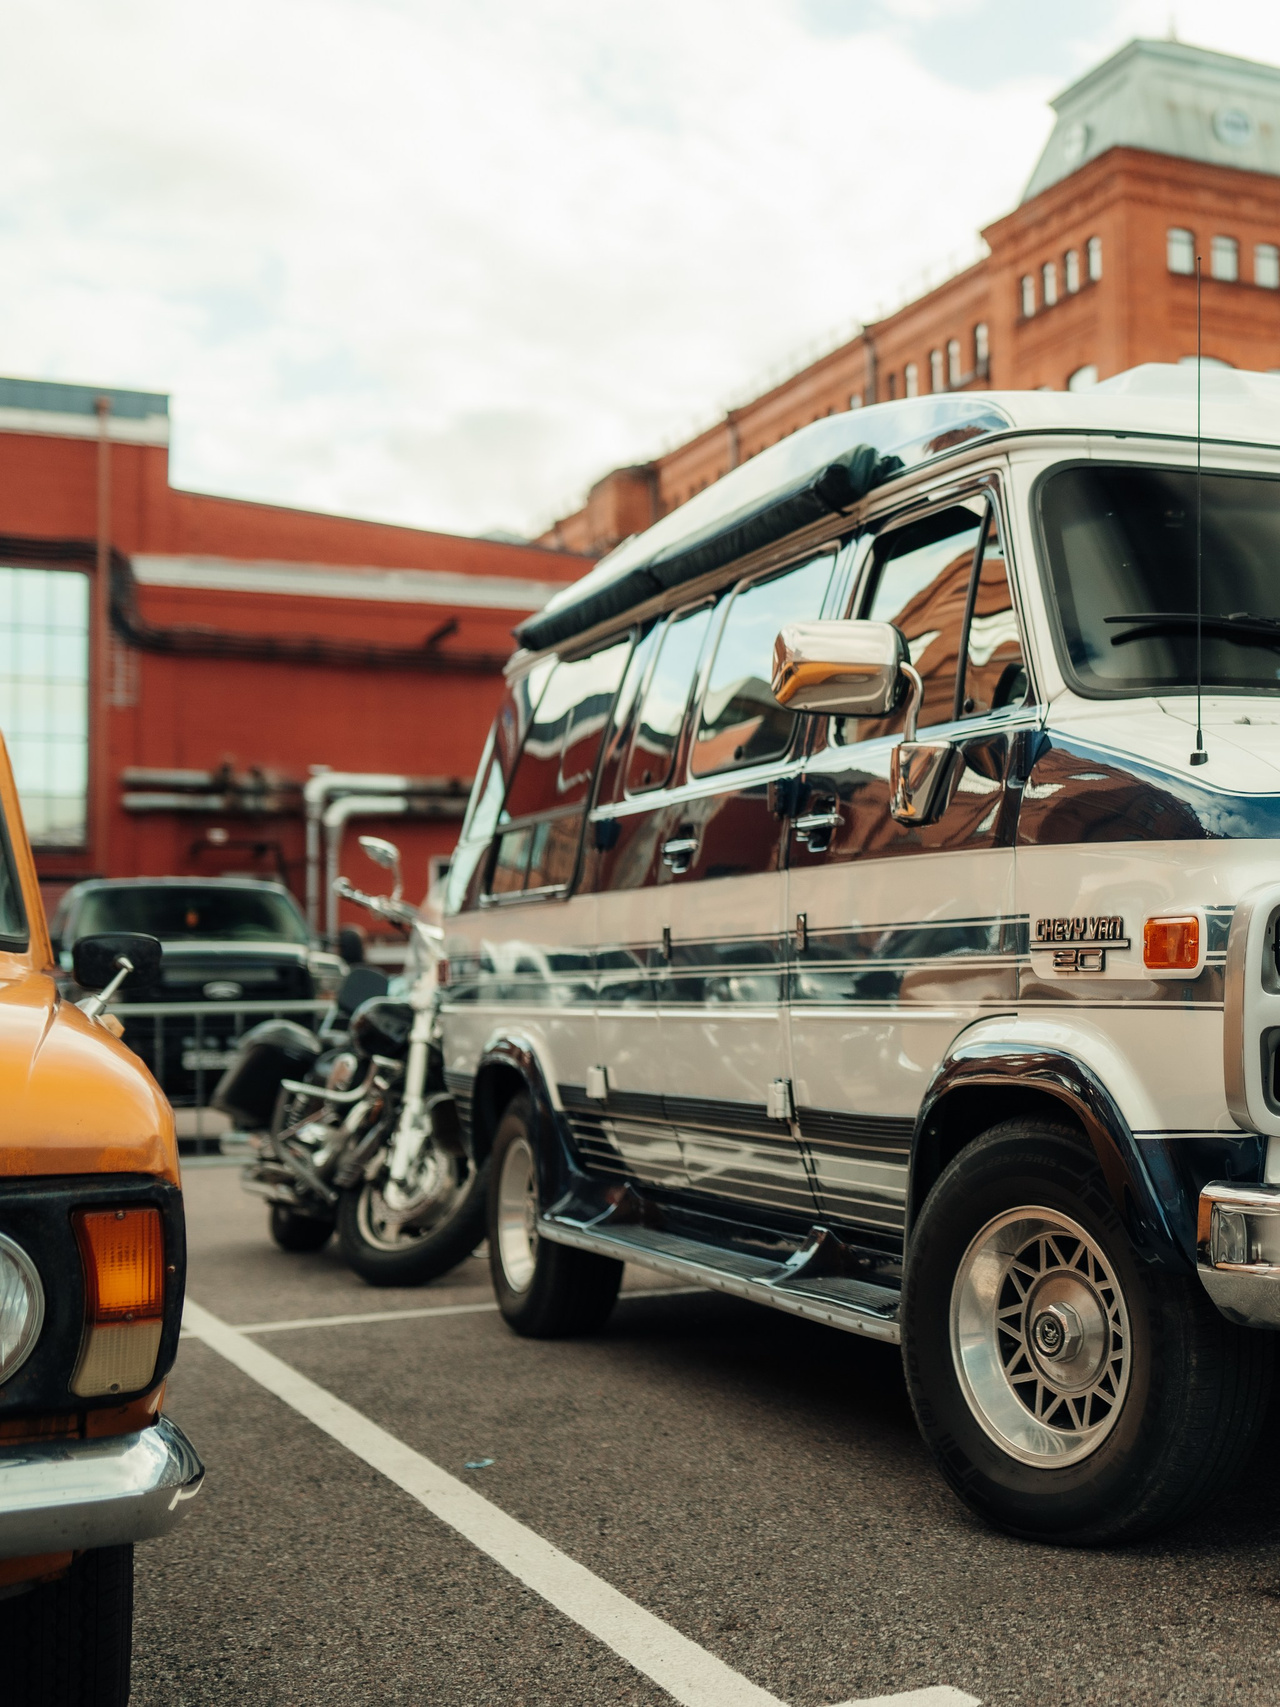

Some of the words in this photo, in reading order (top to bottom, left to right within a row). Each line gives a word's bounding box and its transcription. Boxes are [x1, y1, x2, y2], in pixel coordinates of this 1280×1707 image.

[1035, 917, 1087, 941] CHEVY
[1089, 916, 1124, 940] VAN
[1052, 949, 1106, 973] 20
